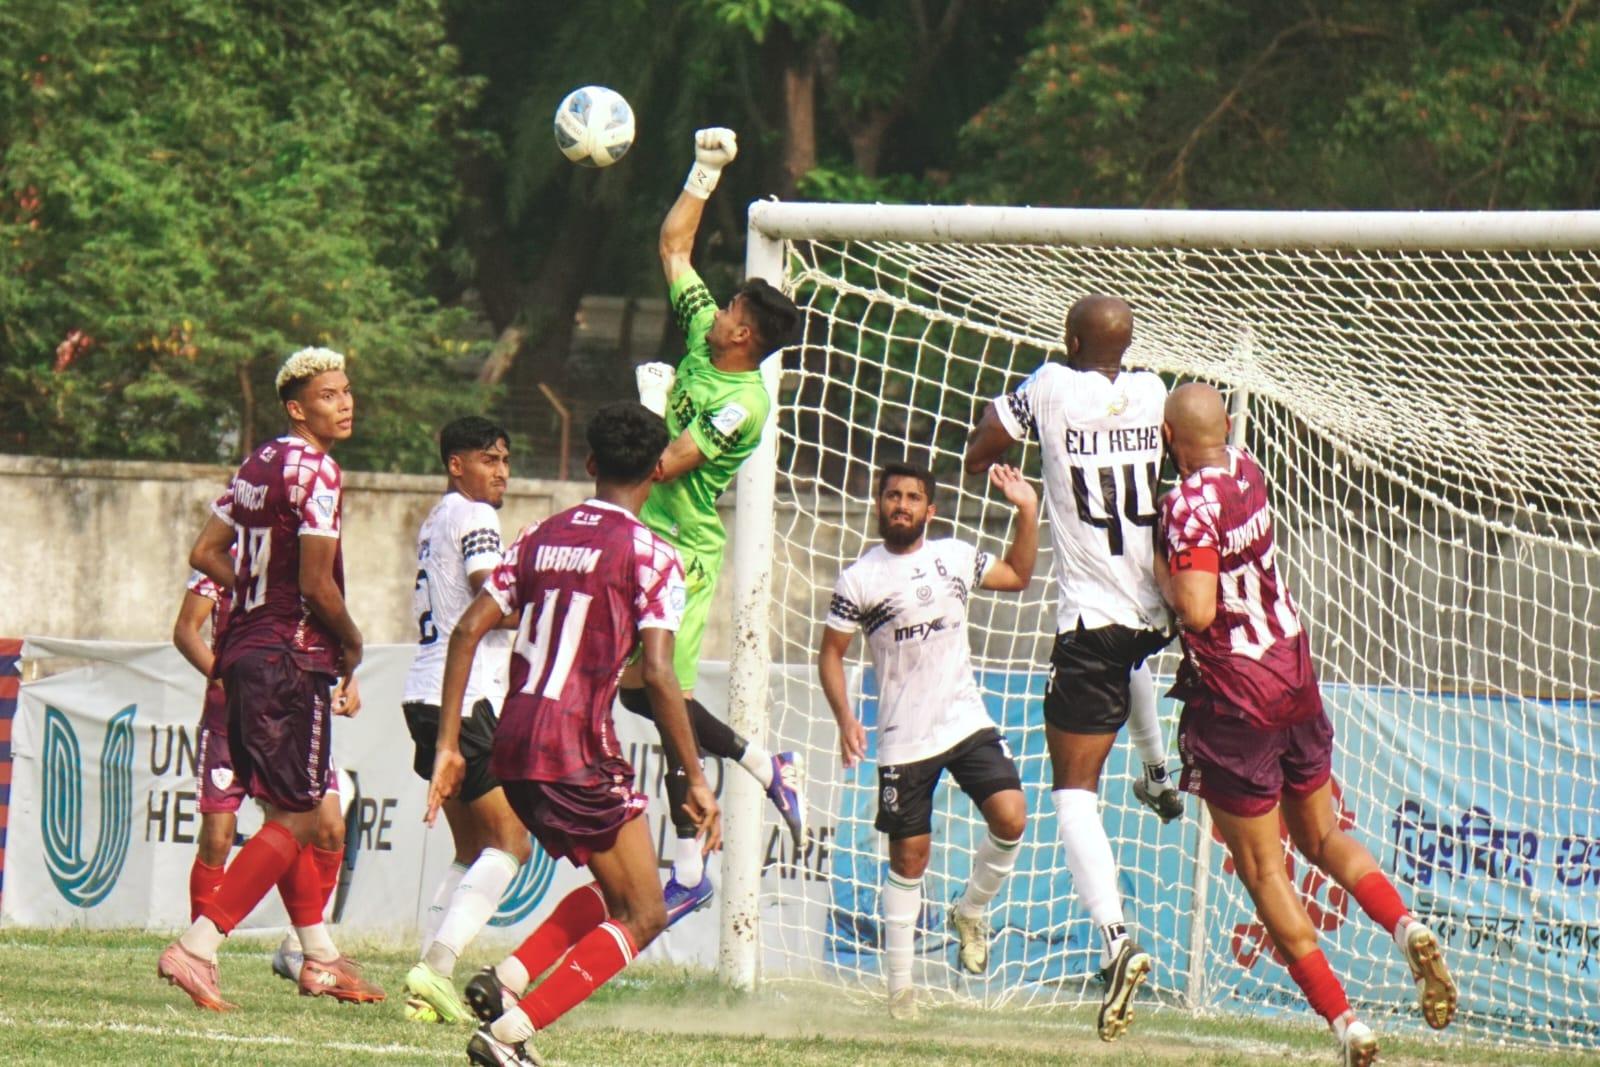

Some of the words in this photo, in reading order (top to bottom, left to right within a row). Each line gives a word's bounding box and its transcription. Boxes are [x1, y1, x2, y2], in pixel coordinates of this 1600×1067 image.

[1065, 428, 1098, 456] ELI
[934, 558, 948, 577] 6
[1176, 550, 1193, 570] C
[894, 616, 946, 641] MAX
[514, 588, 594, 700] 41
